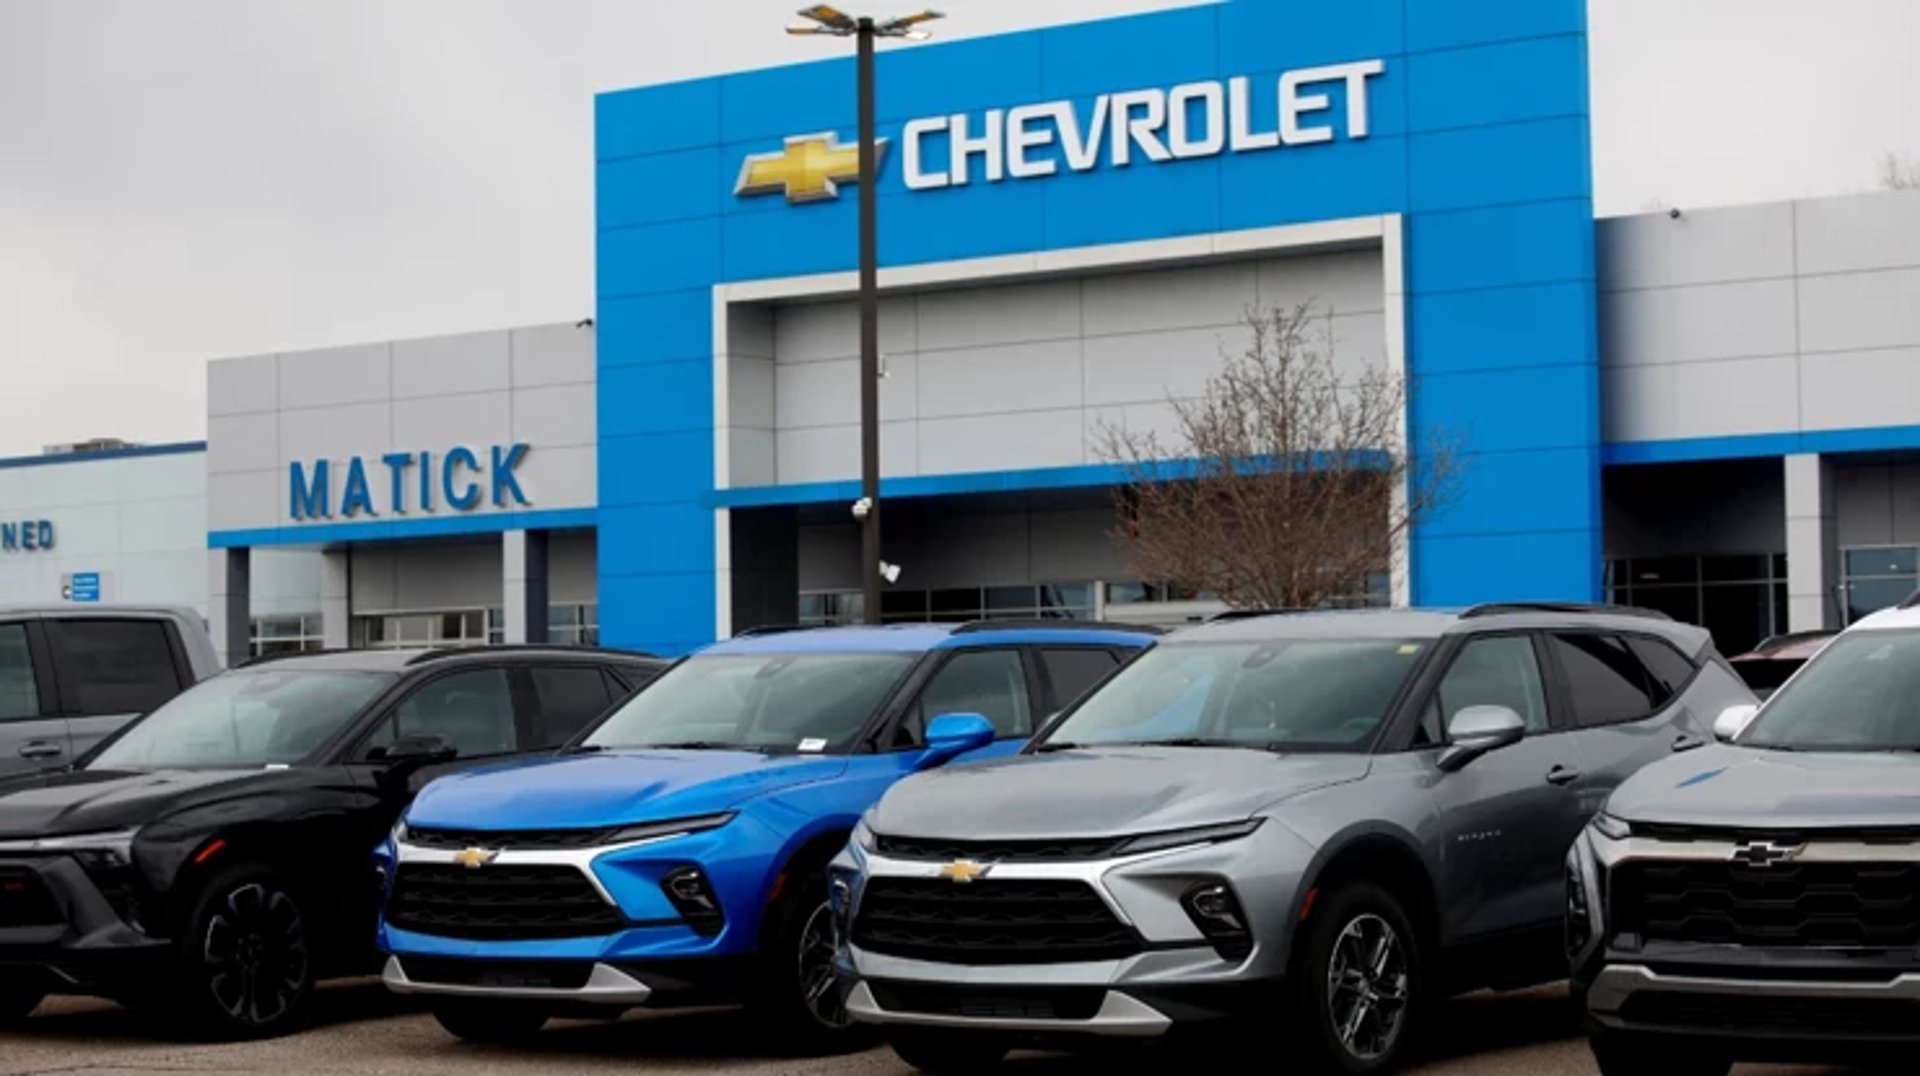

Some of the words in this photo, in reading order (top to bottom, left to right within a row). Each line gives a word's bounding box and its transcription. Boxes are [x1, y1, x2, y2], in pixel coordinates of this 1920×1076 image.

[903, 59, 1385, 190] CHEVROLET
[290, 443, 531, 520] MATICK
[1, 520, 55, 551] NED
